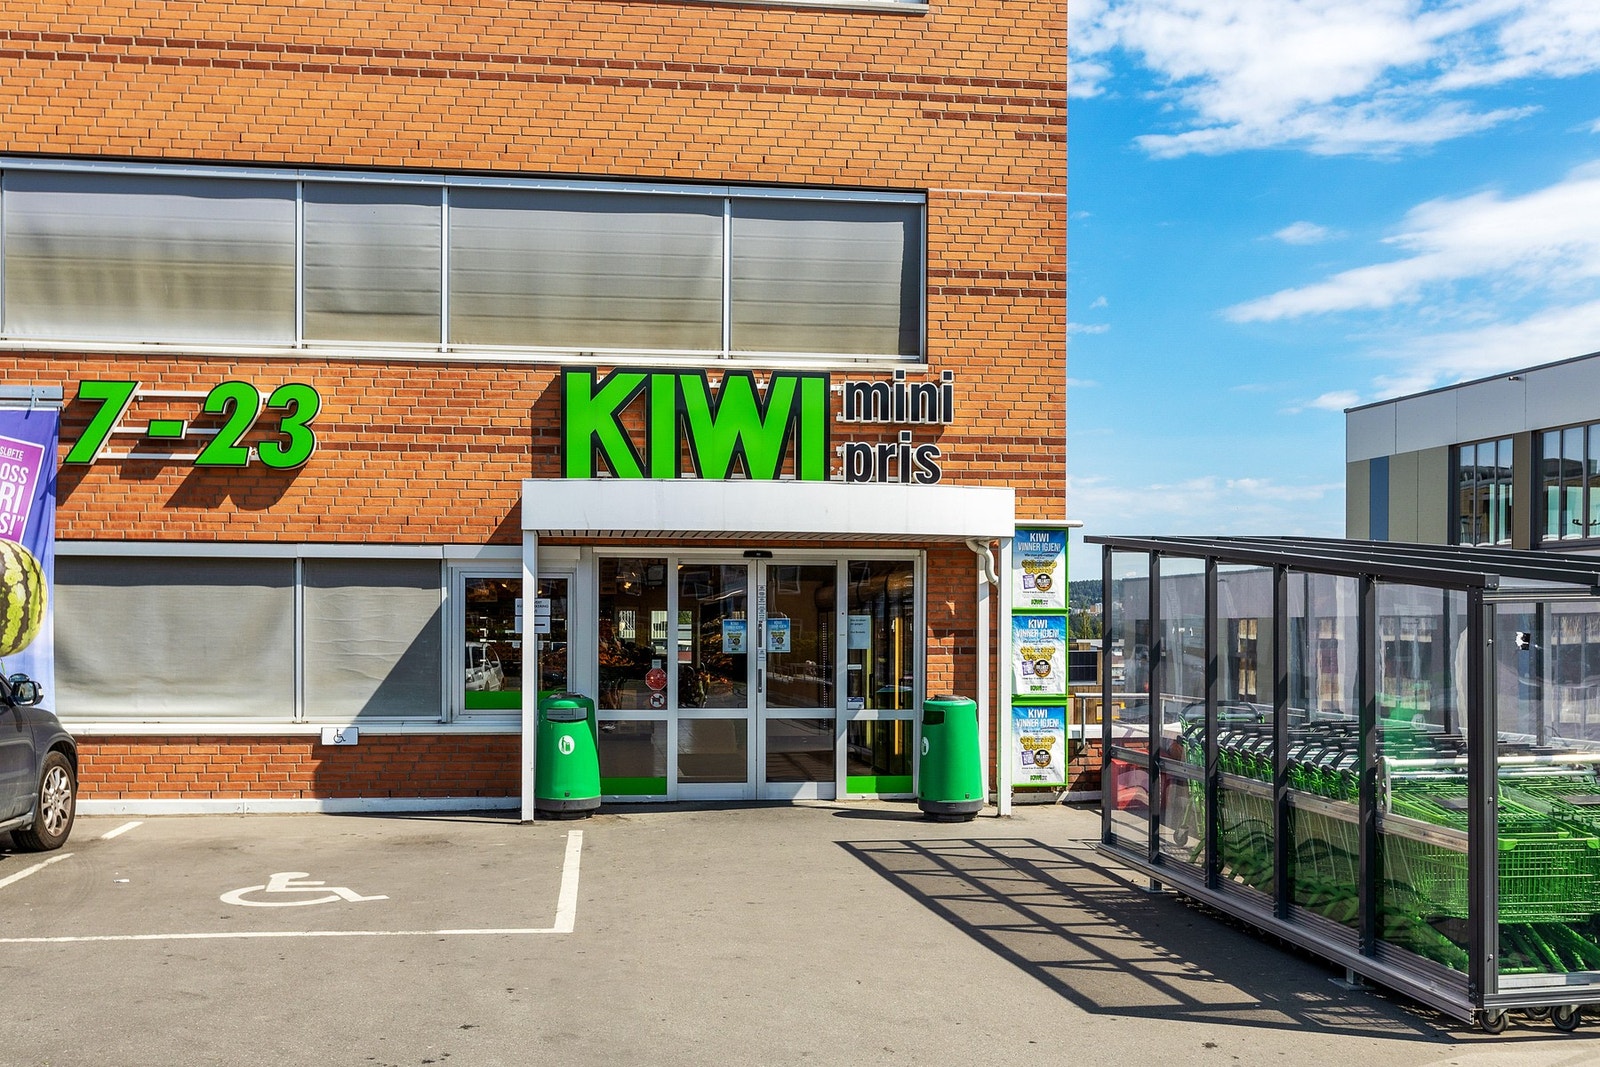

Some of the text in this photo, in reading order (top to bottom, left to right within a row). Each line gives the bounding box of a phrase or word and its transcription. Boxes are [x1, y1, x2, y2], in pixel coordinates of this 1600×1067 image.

[842, 369, 954, 424] mini
[561, 367, 830, 481] KIWI
[842, 430, 942, 485] pris
[0, 462, 29, 485] OSS
[1030, 533, 1049, 542] KIWI
[1028, 619, 1048, 628] KIWI
[1028, 709, 1048, 718] KIWI
